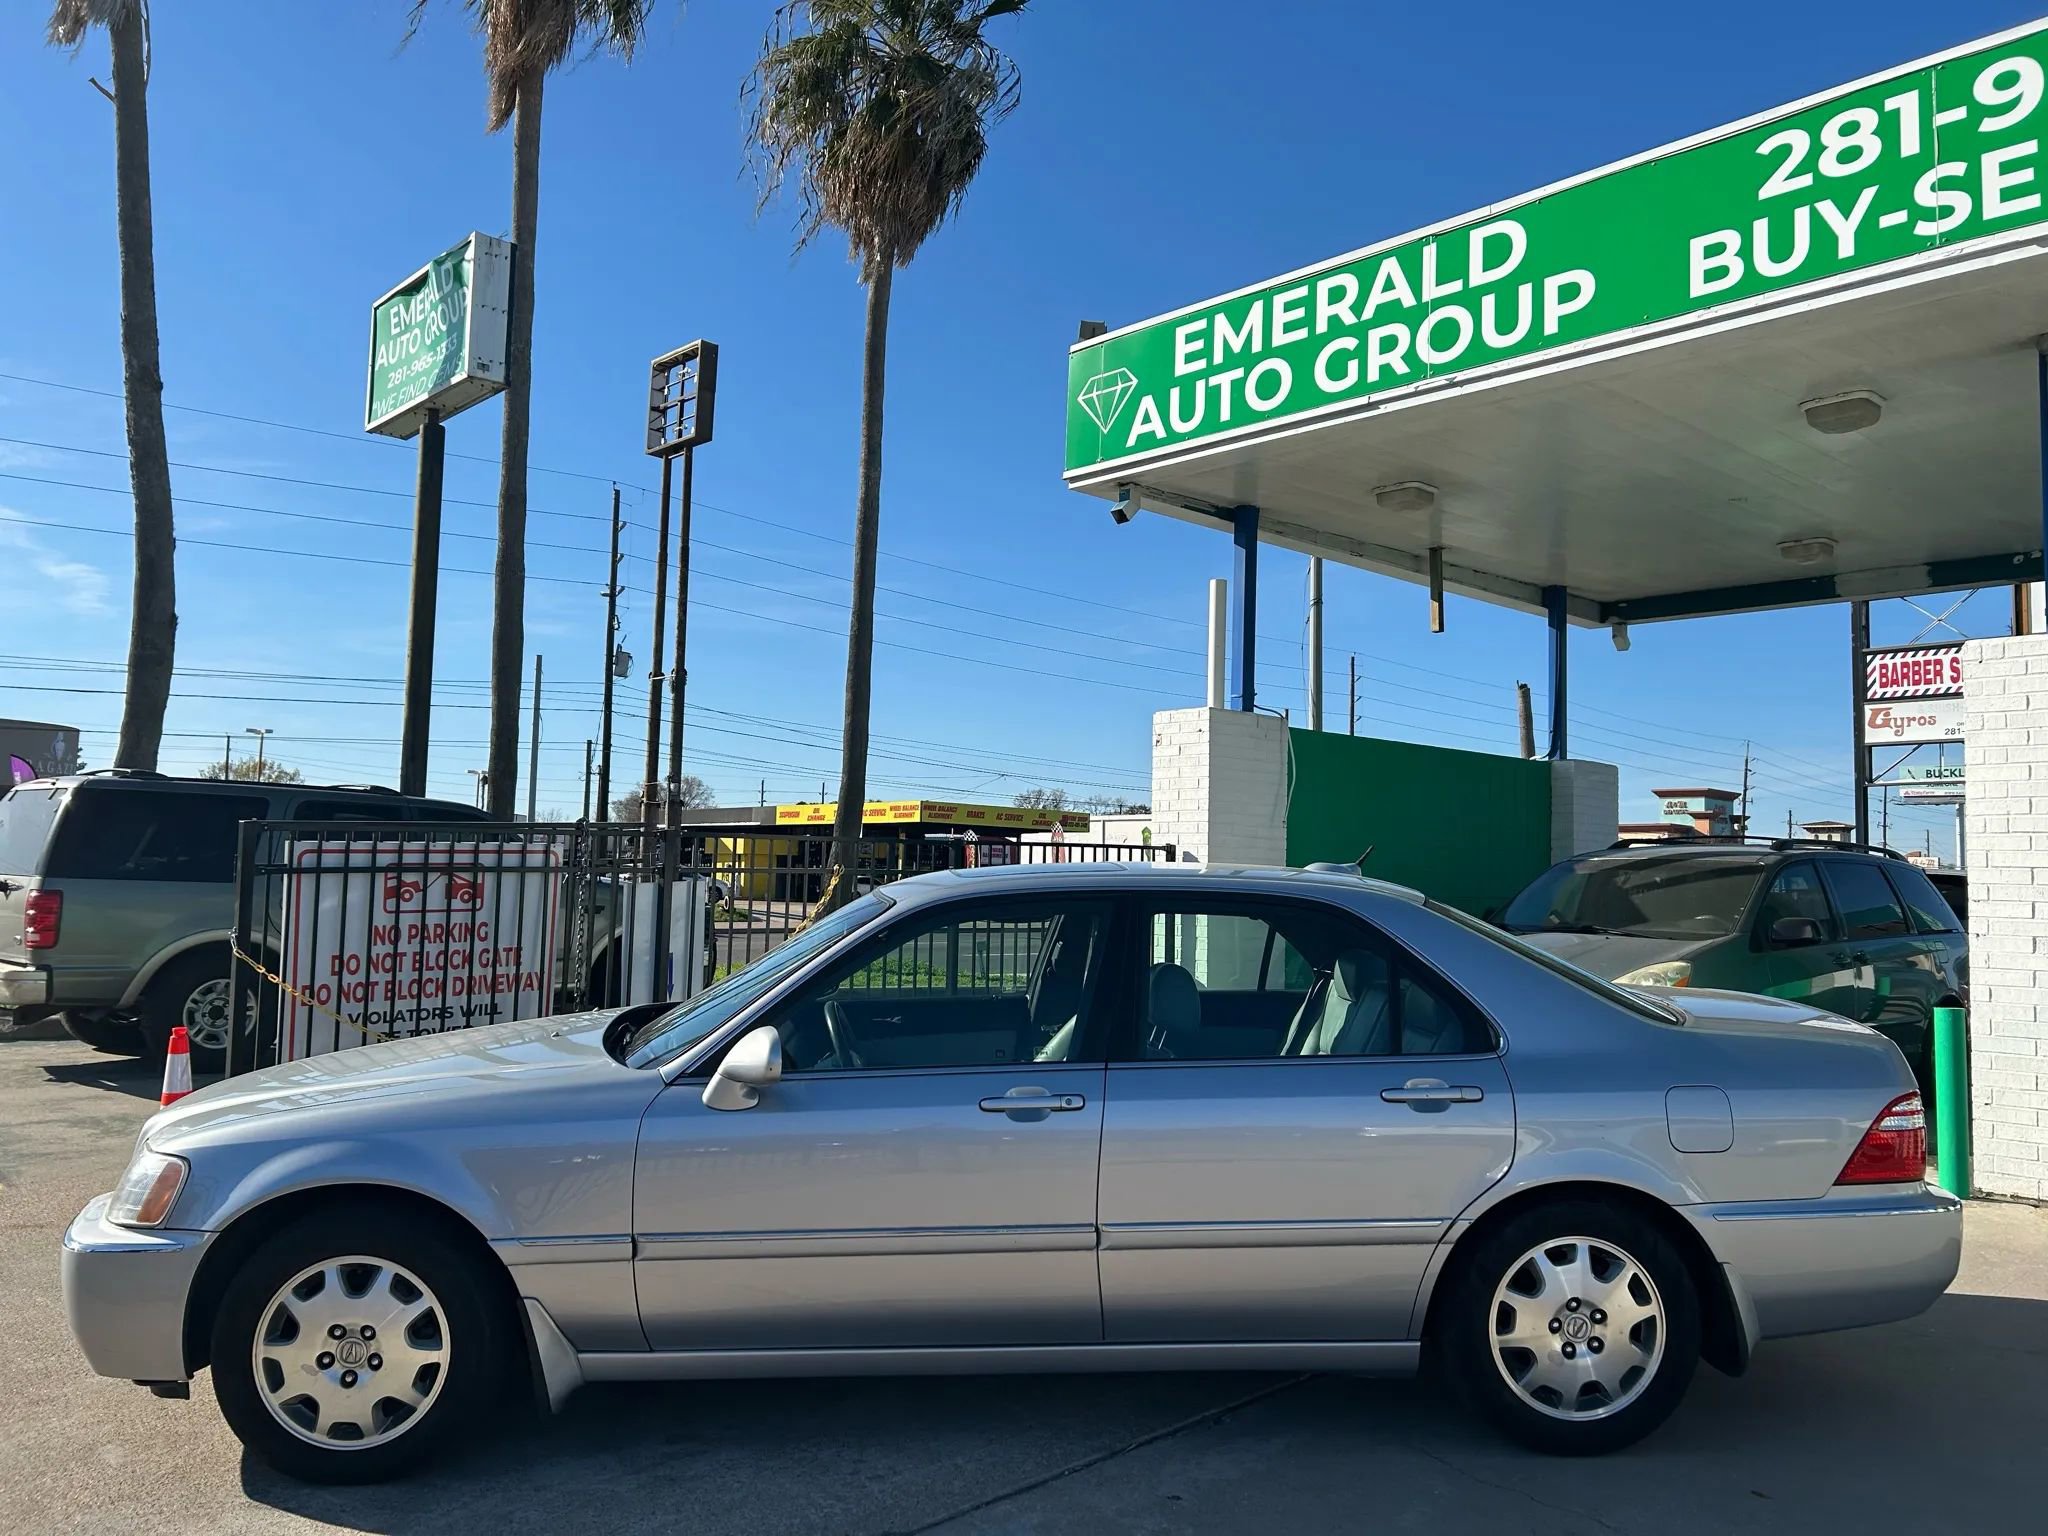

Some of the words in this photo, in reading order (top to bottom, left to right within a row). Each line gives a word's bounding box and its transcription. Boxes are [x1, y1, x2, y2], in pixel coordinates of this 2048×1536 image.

[1754, 55, 2046, 202] 281-9
[1688, 138, 2042, 300] BUY-SE
[389, 261, 454, 336] EMERALD
[1173, 218, 1528, 378] EMERALD
[375, 327, 421, 371] AUTO
[424, 285, 469, 346] GROUP
[1125, 356, 1293, 449] AUTO
[1313, 268, 1597, 394] GROUP
[398, 377, 427, 407] FIND
[1878, 658, 1944, 689] BARBER
[1949, 656, 1964, 684] S
[1867, 707, 1937, 737] Gyros
[373, 925, 402, 947] NO
[407, 921, 489, 945] PARKING
[330, 954, 361, 977] DO
[367, 951, 407, 974] NOT
[411, 948, 471, 972] BLOCK
[478, 946, 523, 969] GATE
[300, 983, 331, 1007] DO
[339, 981, 380, 1004] NOT
[384, 976, 445, 1001] BLOCK
[451, 971, 546, 997] DRIVEWAY
[459, 1003, 503, 1018] WILL
